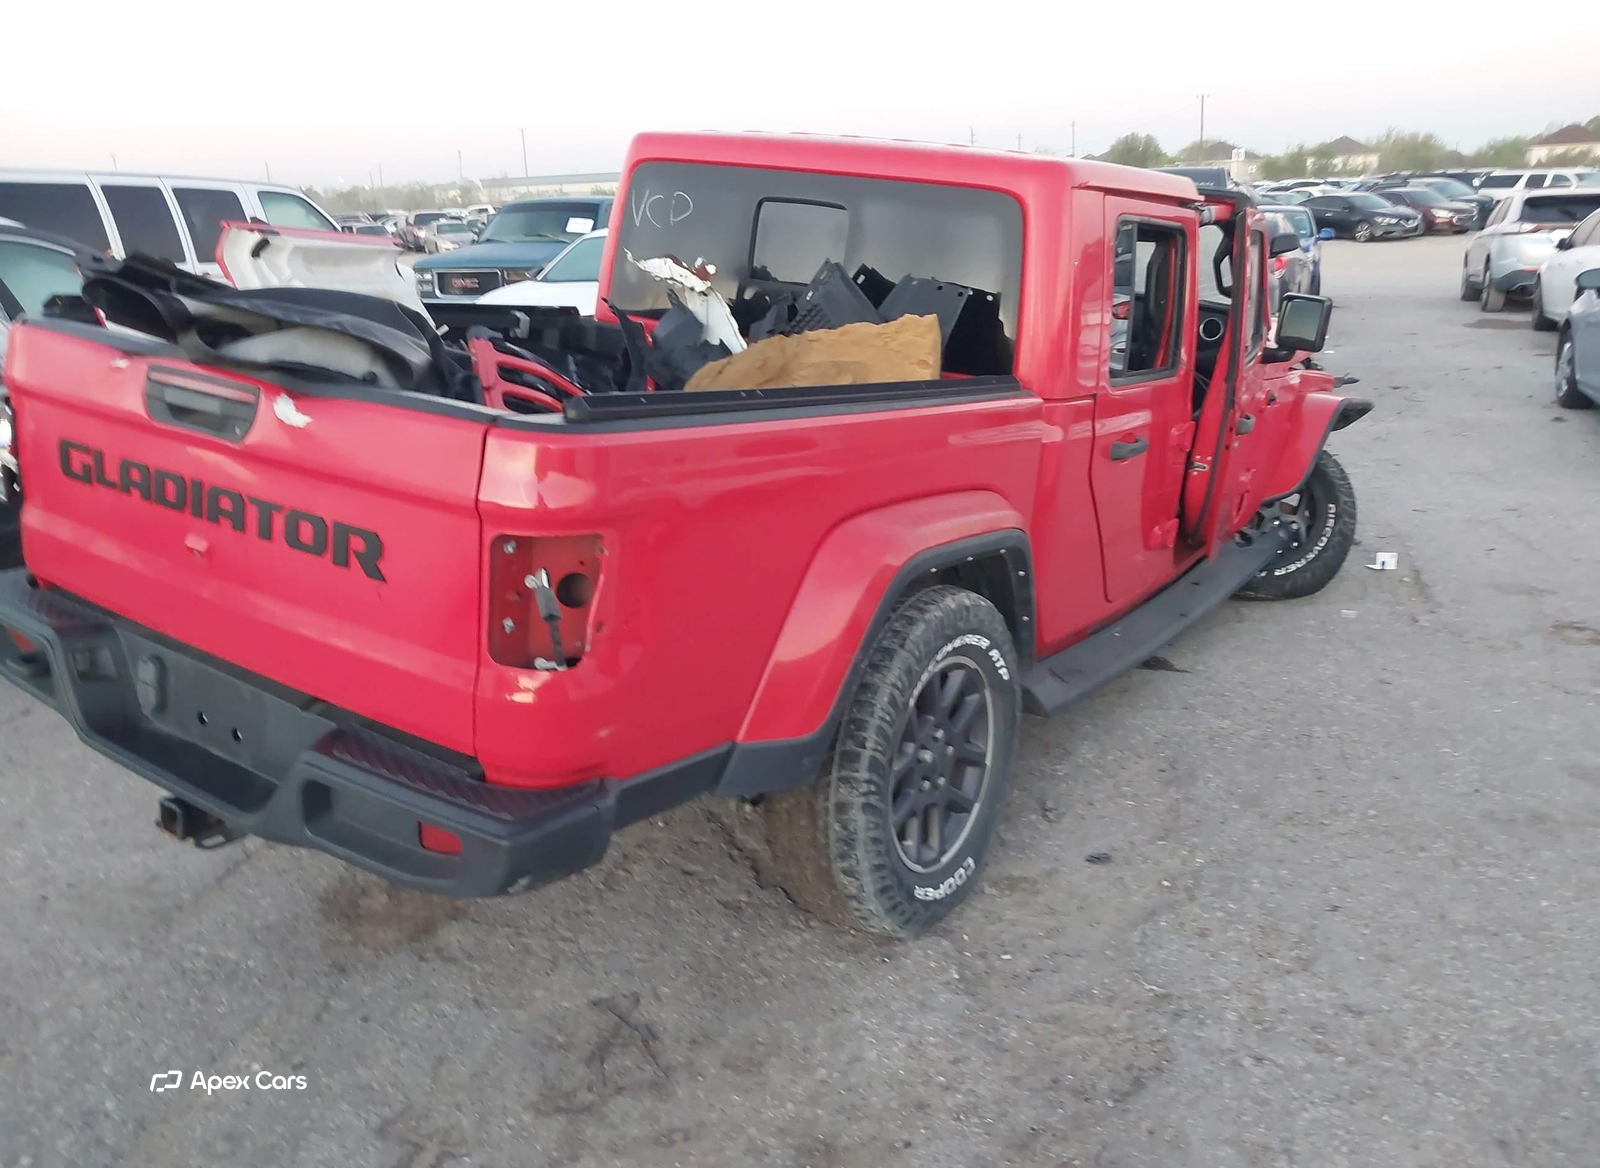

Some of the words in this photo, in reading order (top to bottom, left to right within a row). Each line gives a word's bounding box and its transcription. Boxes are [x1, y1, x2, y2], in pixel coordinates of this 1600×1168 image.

[631, 189, 694, 228] VCD
[451, 277, 480, 289] GMC
[58, 438, 387, 584] GLADIATOR
[914, 856, 976, 901] COOPER
